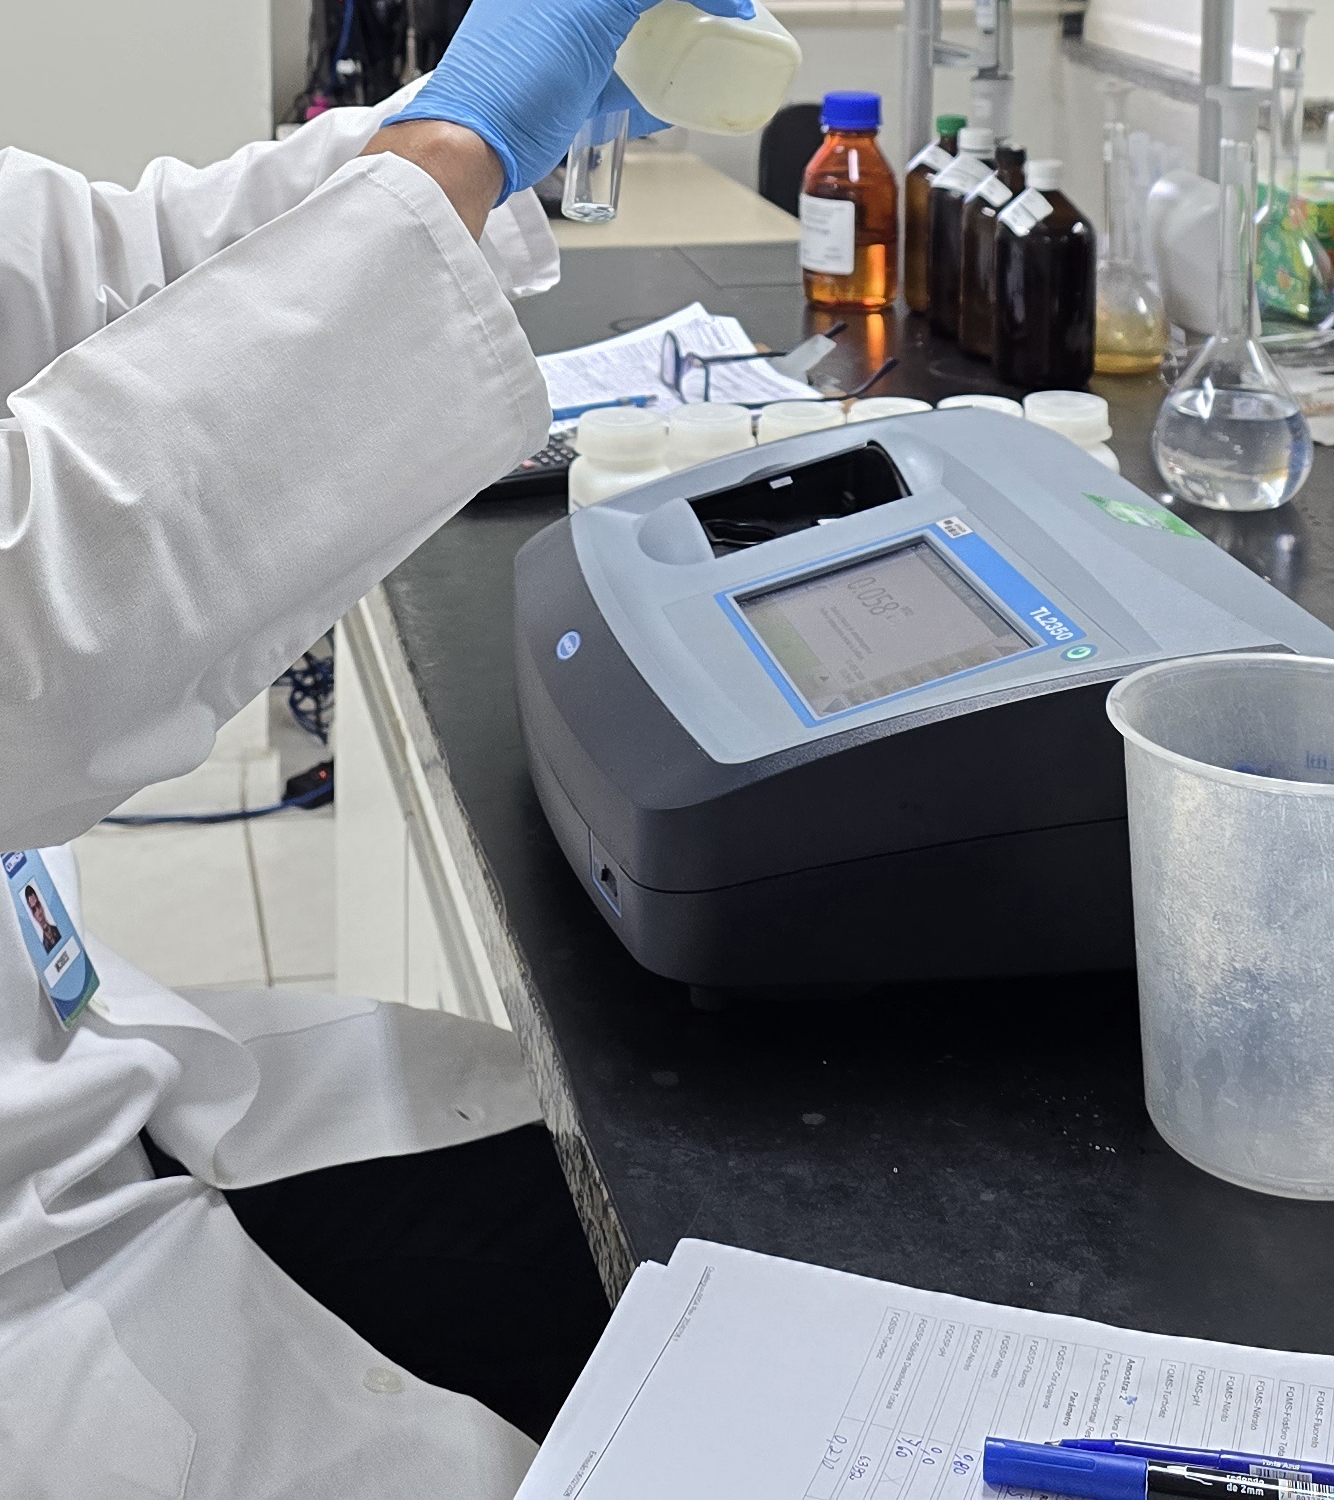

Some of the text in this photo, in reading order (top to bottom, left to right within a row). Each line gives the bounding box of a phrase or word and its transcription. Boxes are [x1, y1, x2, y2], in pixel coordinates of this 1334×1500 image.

[1029, 606, 1074, 641] TL2350
[1121, 1358, 1136, 1394] Amostra:
[1062, 1390, 1079, 1427] Parâmetro
[1277, 1442, 1289, 1456] Tota
[1226, 1483, 1265, 1497] de 2mm
